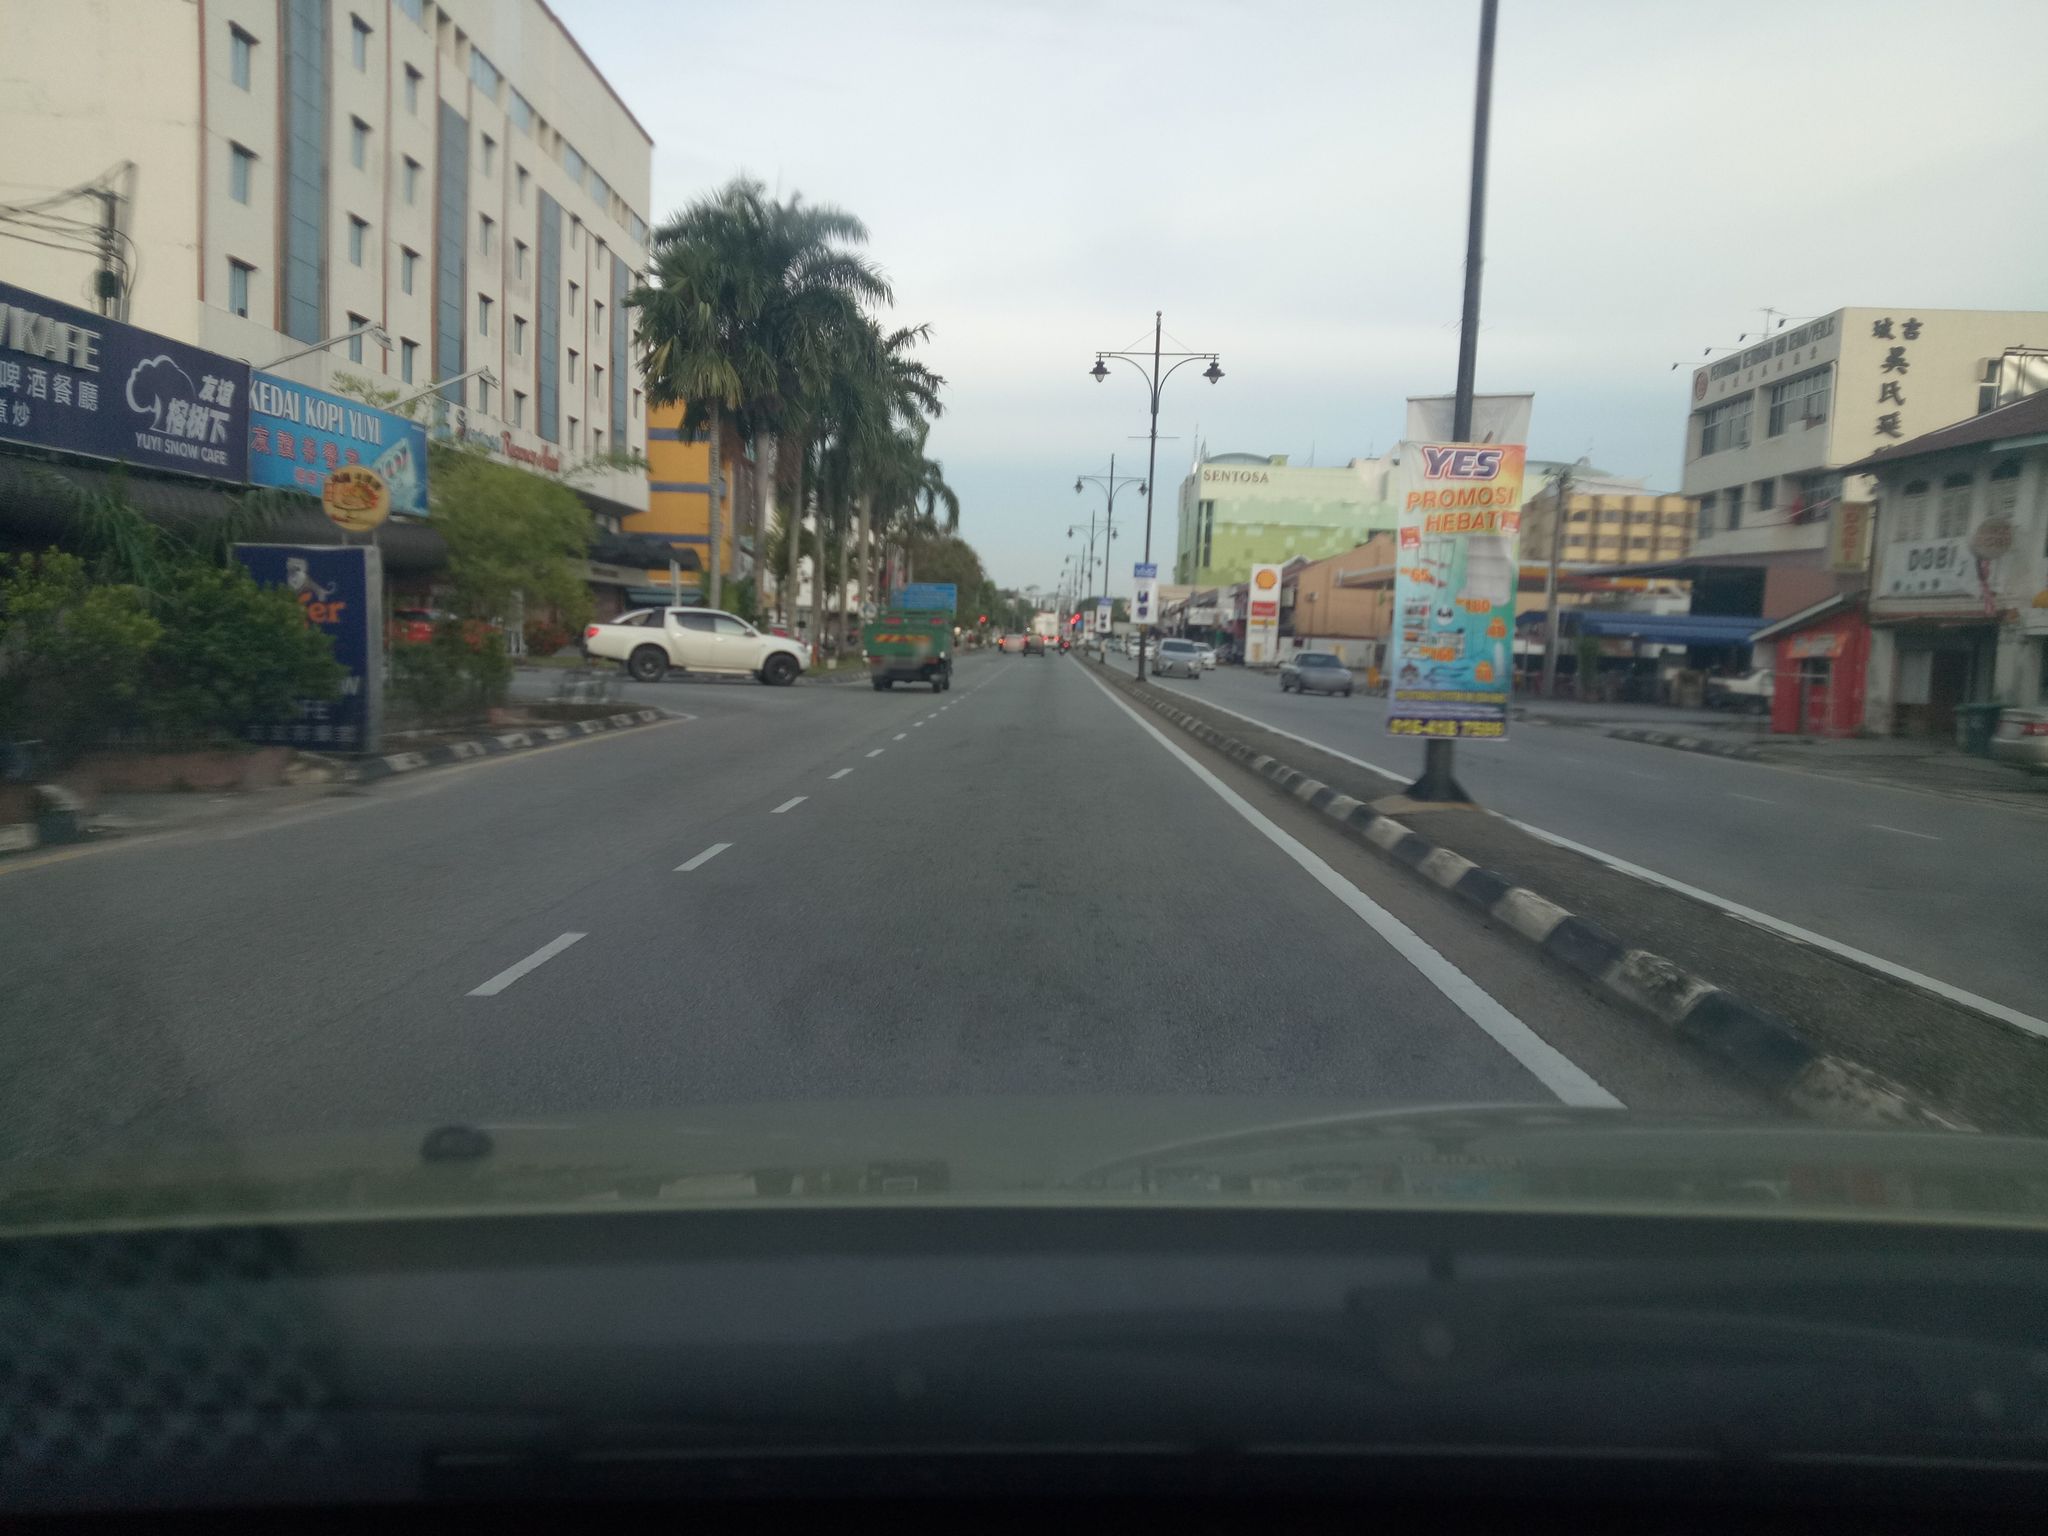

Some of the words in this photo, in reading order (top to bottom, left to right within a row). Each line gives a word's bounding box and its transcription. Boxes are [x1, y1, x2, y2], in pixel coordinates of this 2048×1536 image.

[249, 379, 301, 424] KEDAI
[305, 396, 344, 437] KOPI
[349, 408, 382, 446] YUYI
[135, 432, 163, 452] YUYI
[164, 438, 199, 459] SNOW
[201, 447, 229, 466] CAFE
[1422, 446, 1503, 480] YES
[1203, 469, 1269, 483] SENTOSA
[1406, 487, 1515, 512] PROMOSI
[1424, 511, 1500, 533] HEBAT
